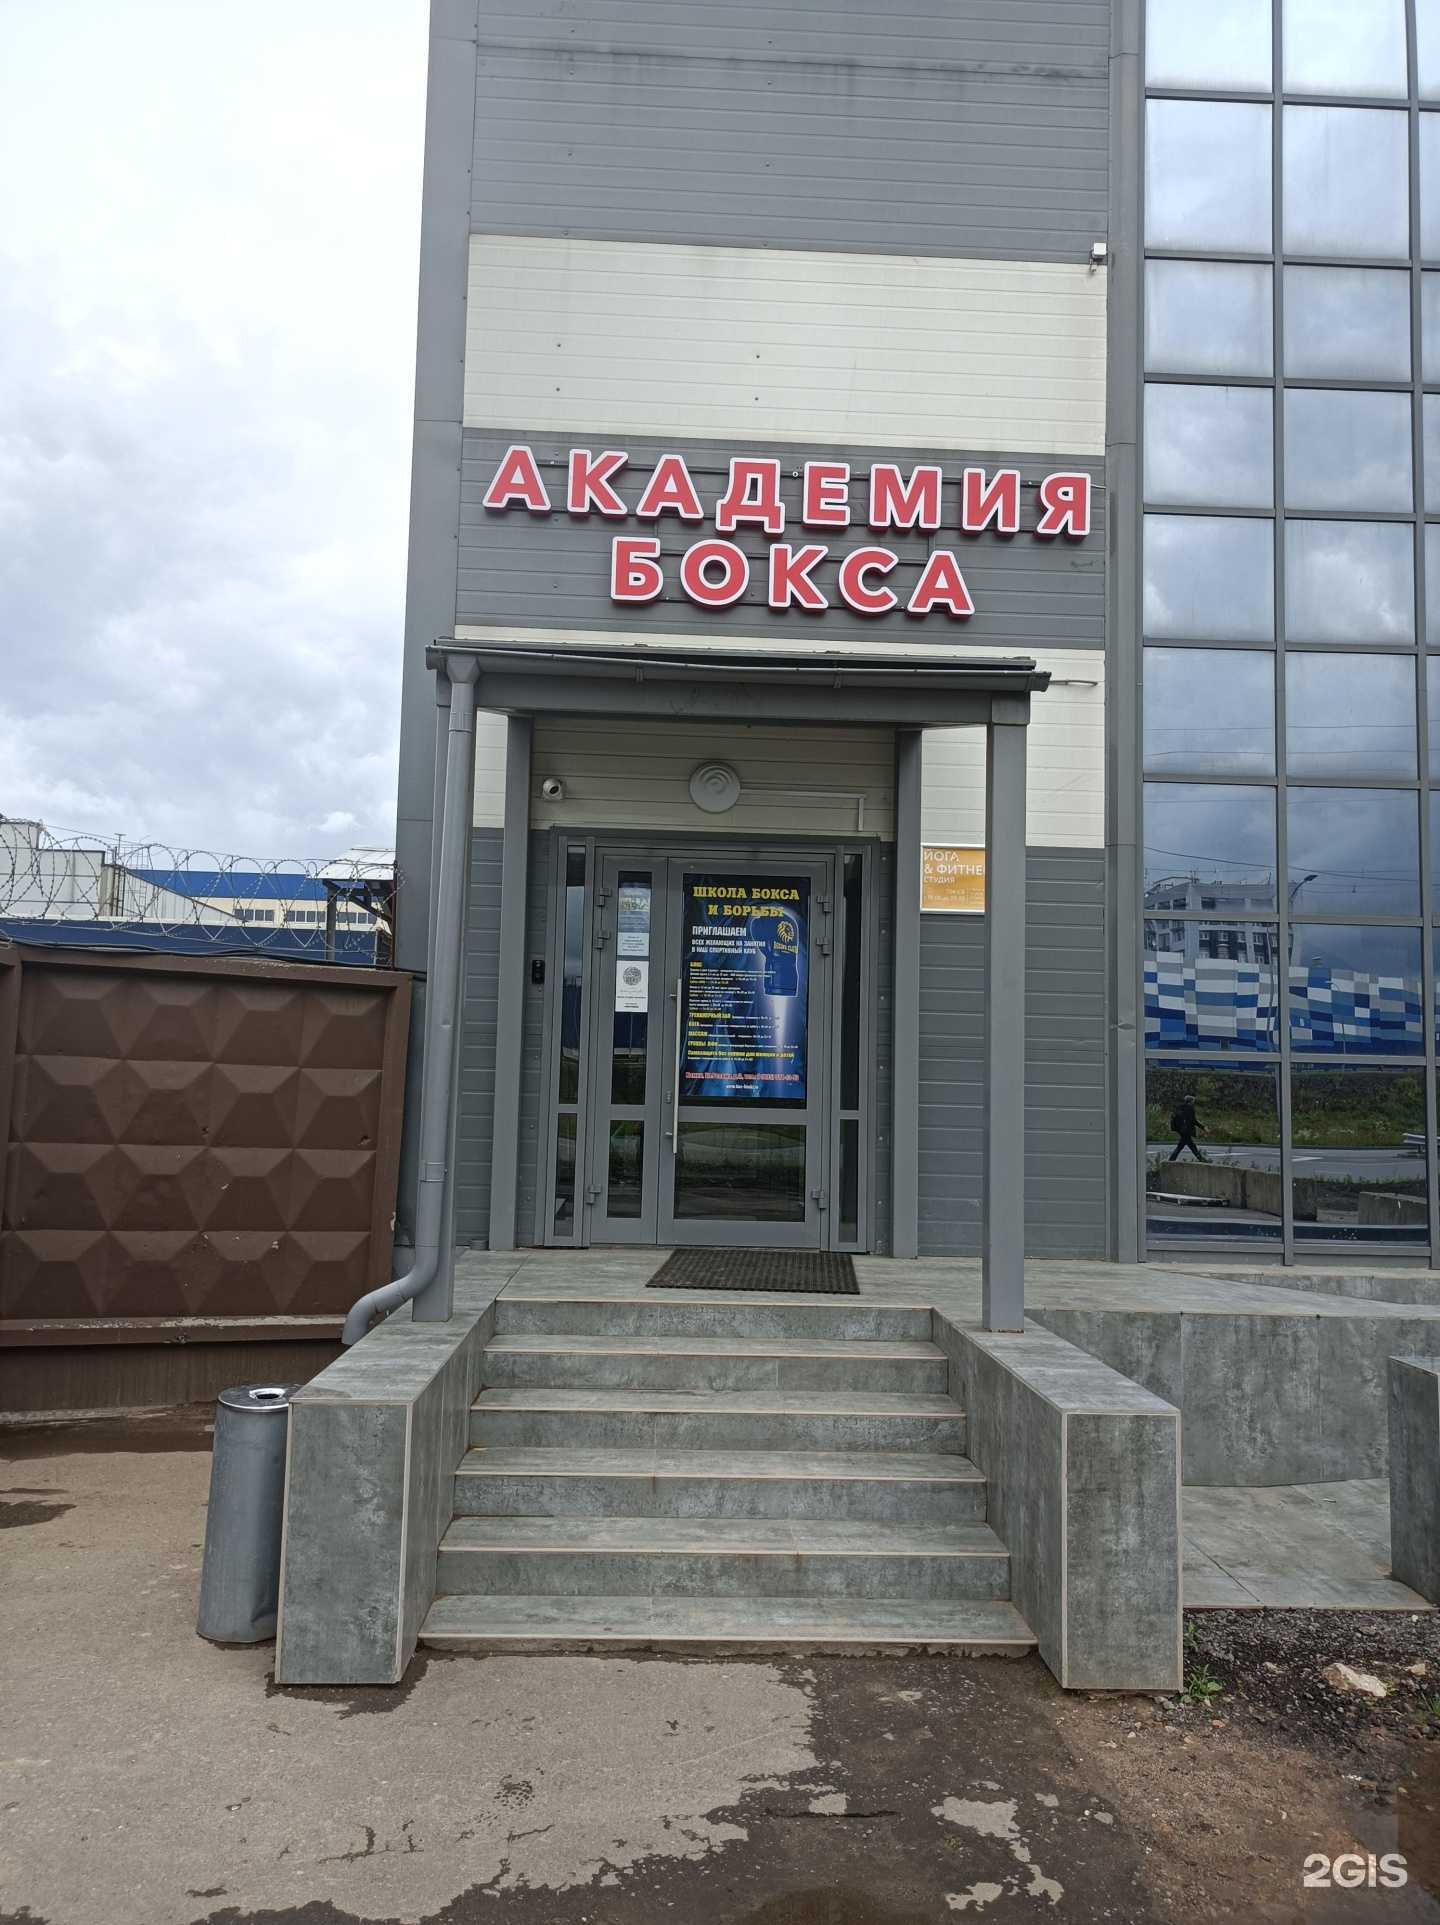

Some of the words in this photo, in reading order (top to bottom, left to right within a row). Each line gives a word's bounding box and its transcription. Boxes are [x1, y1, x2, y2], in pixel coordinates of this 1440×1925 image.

[484, 446, 1091, 537] АКАДЕМИЯ
[611, 536, 975, 615] БОКСА
[924, 849, 959, 861] ЙОГА
[937, 864, 985, 875] ФИТНЕ
[693, 886, 747, 898] ШКОЛА
[752, 888, 800, 900] БОКСА
[708, 904, 719, 915] И
[723, 905, 784, 917] БОРЬБЫ
[692, 926, 747, 936] ПРИГЛАШАЕМ
